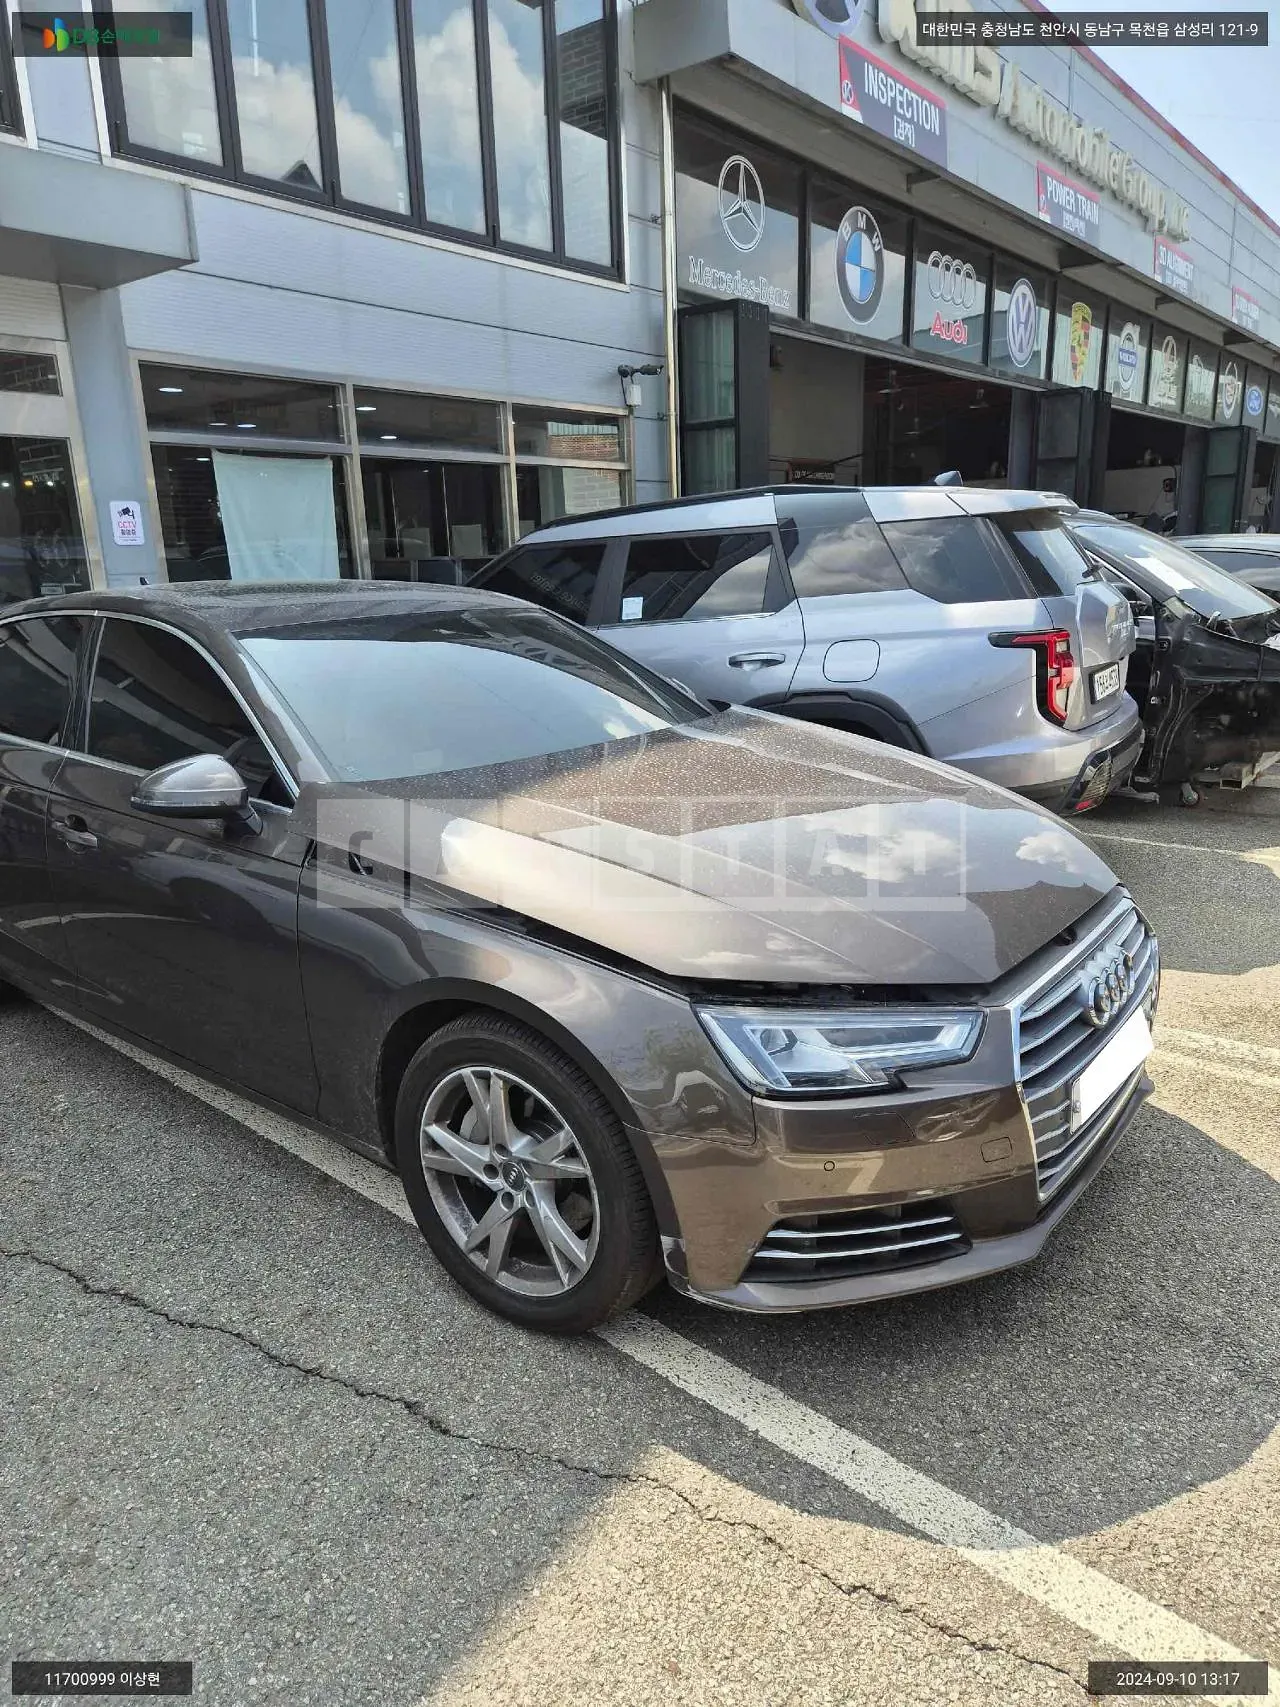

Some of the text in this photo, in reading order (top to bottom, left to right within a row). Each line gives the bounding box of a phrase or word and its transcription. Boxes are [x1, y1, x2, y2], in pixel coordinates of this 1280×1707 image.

[864, 61, 941, 137] INSPECTION
[1046, 175, 1099, 225] POWER TRAIN
[842, 211, 882, 252] BMW
[688, 254, 792, 310] Mercedes-Benz
[930, 310, 968, 346] Audi
